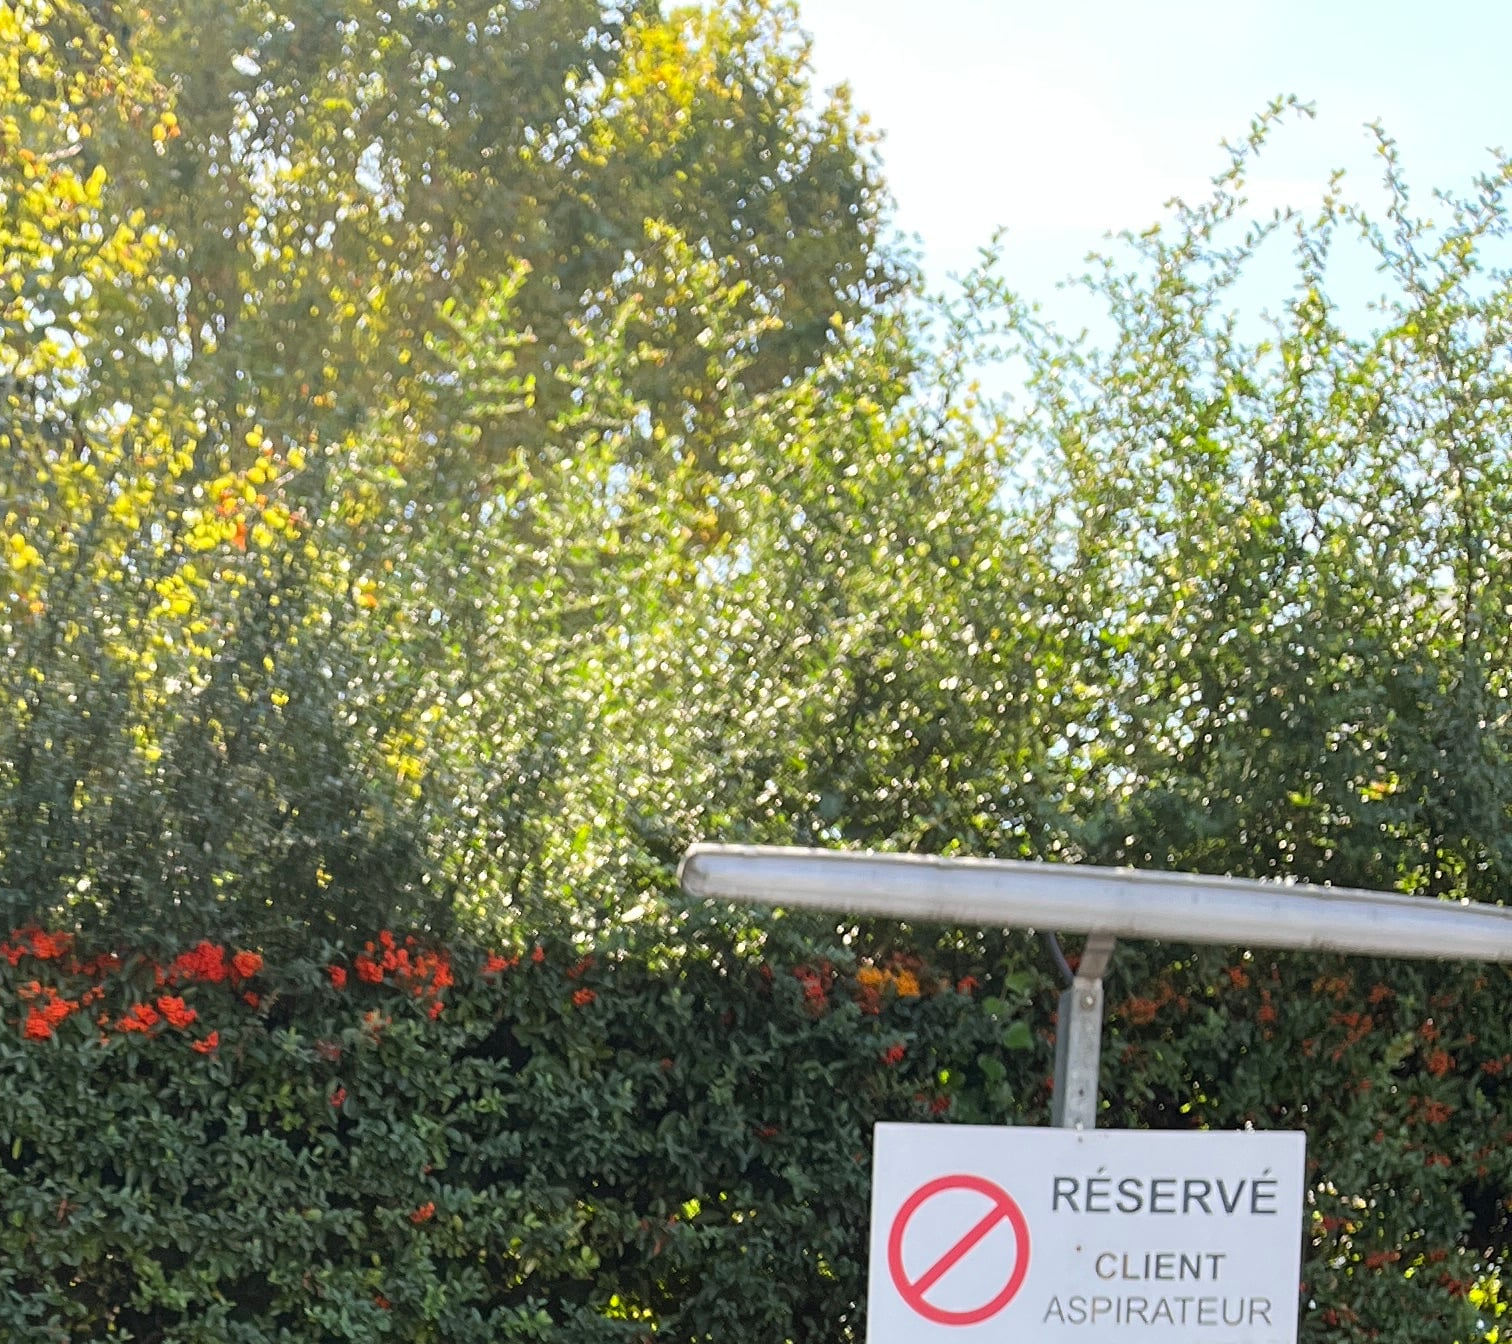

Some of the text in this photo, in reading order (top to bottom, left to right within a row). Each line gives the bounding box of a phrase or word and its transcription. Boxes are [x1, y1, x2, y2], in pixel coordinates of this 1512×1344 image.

[1051, 1166, 1278, 1214] RÉSERVÉ
[1094, 1252, 1227, 1281] CLIENT
[1043, 1296, 1273, 1326] ASPIRATEUR
